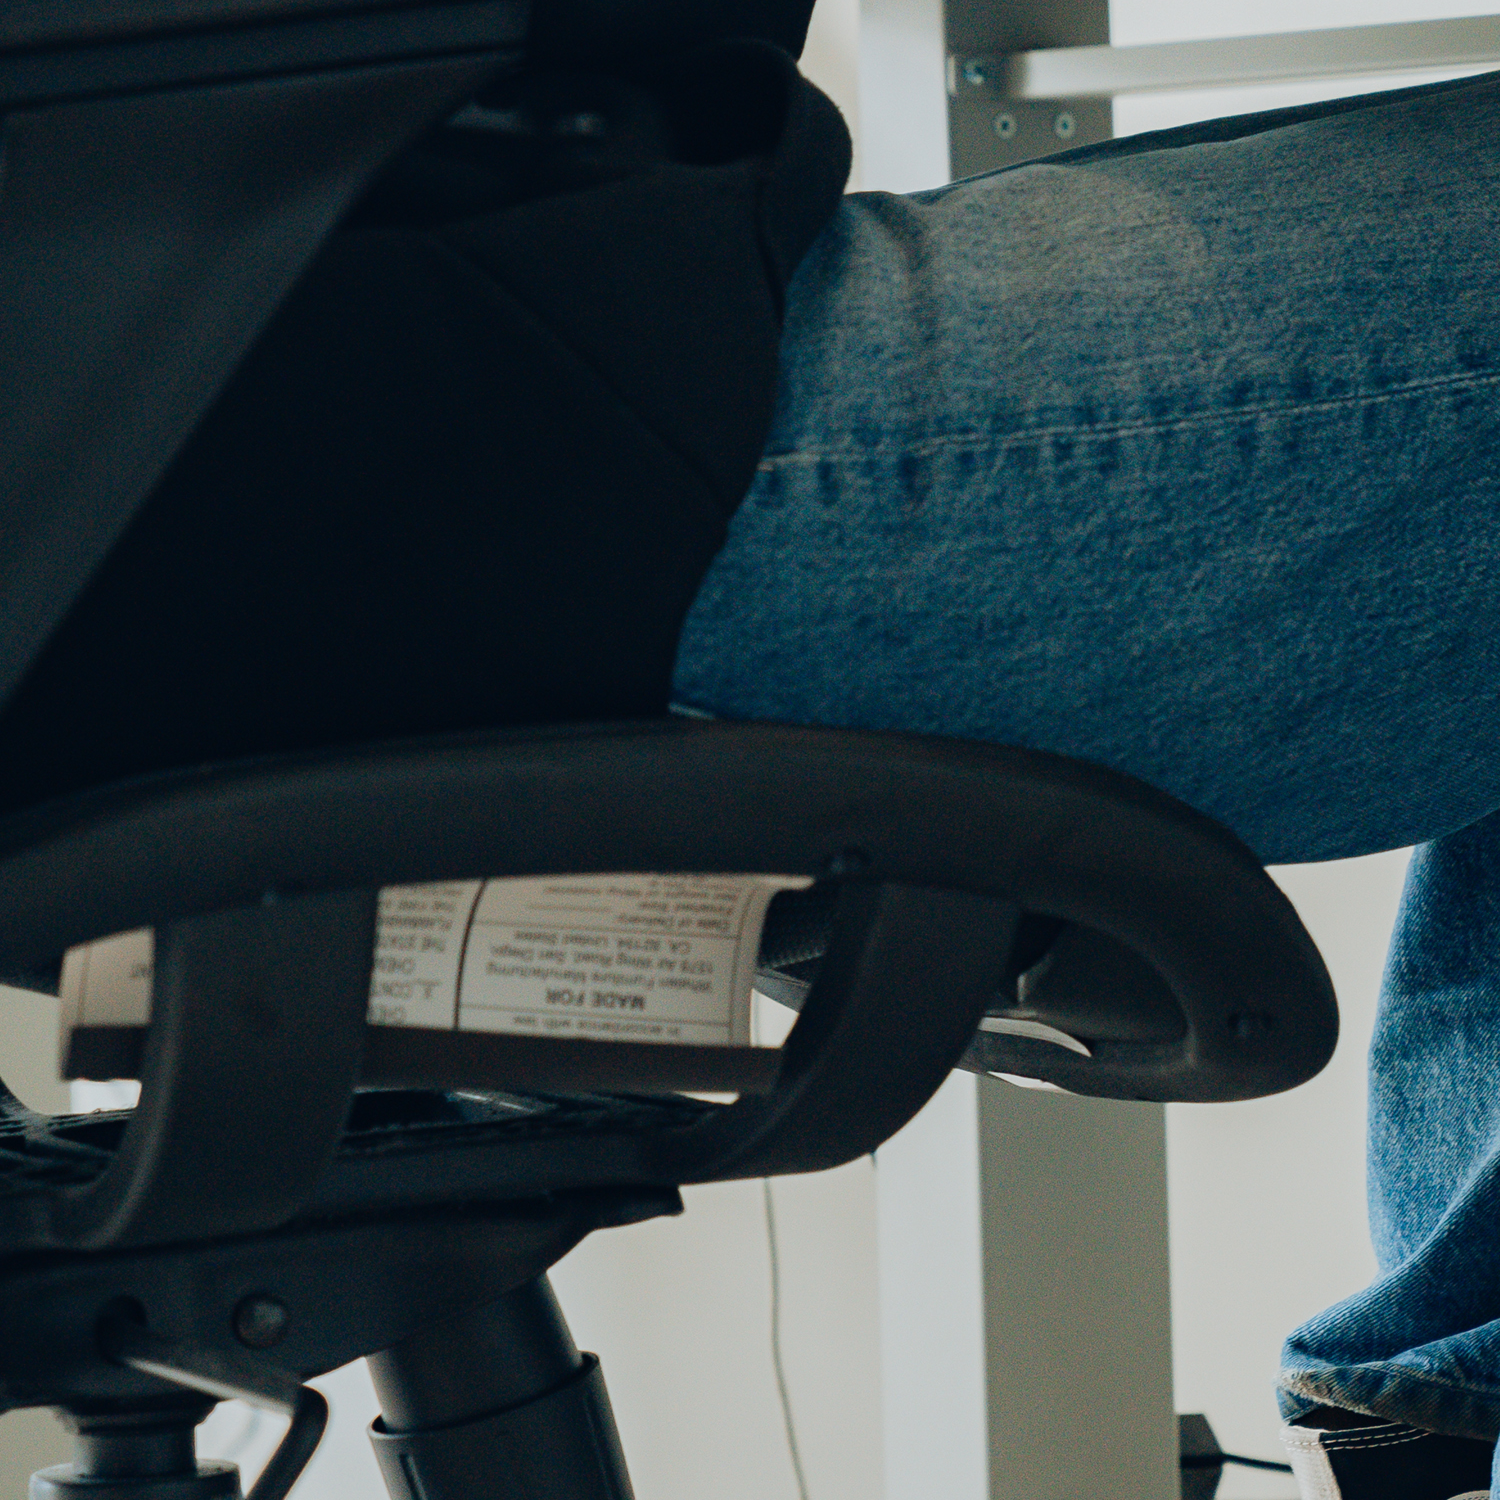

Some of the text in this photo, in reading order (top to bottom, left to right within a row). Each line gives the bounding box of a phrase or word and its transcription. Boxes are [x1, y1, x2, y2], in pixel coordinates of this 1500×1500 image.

[486, 962, 587, 986] Manufacturing
[545, 989, 646, 1012] MADE FOR
